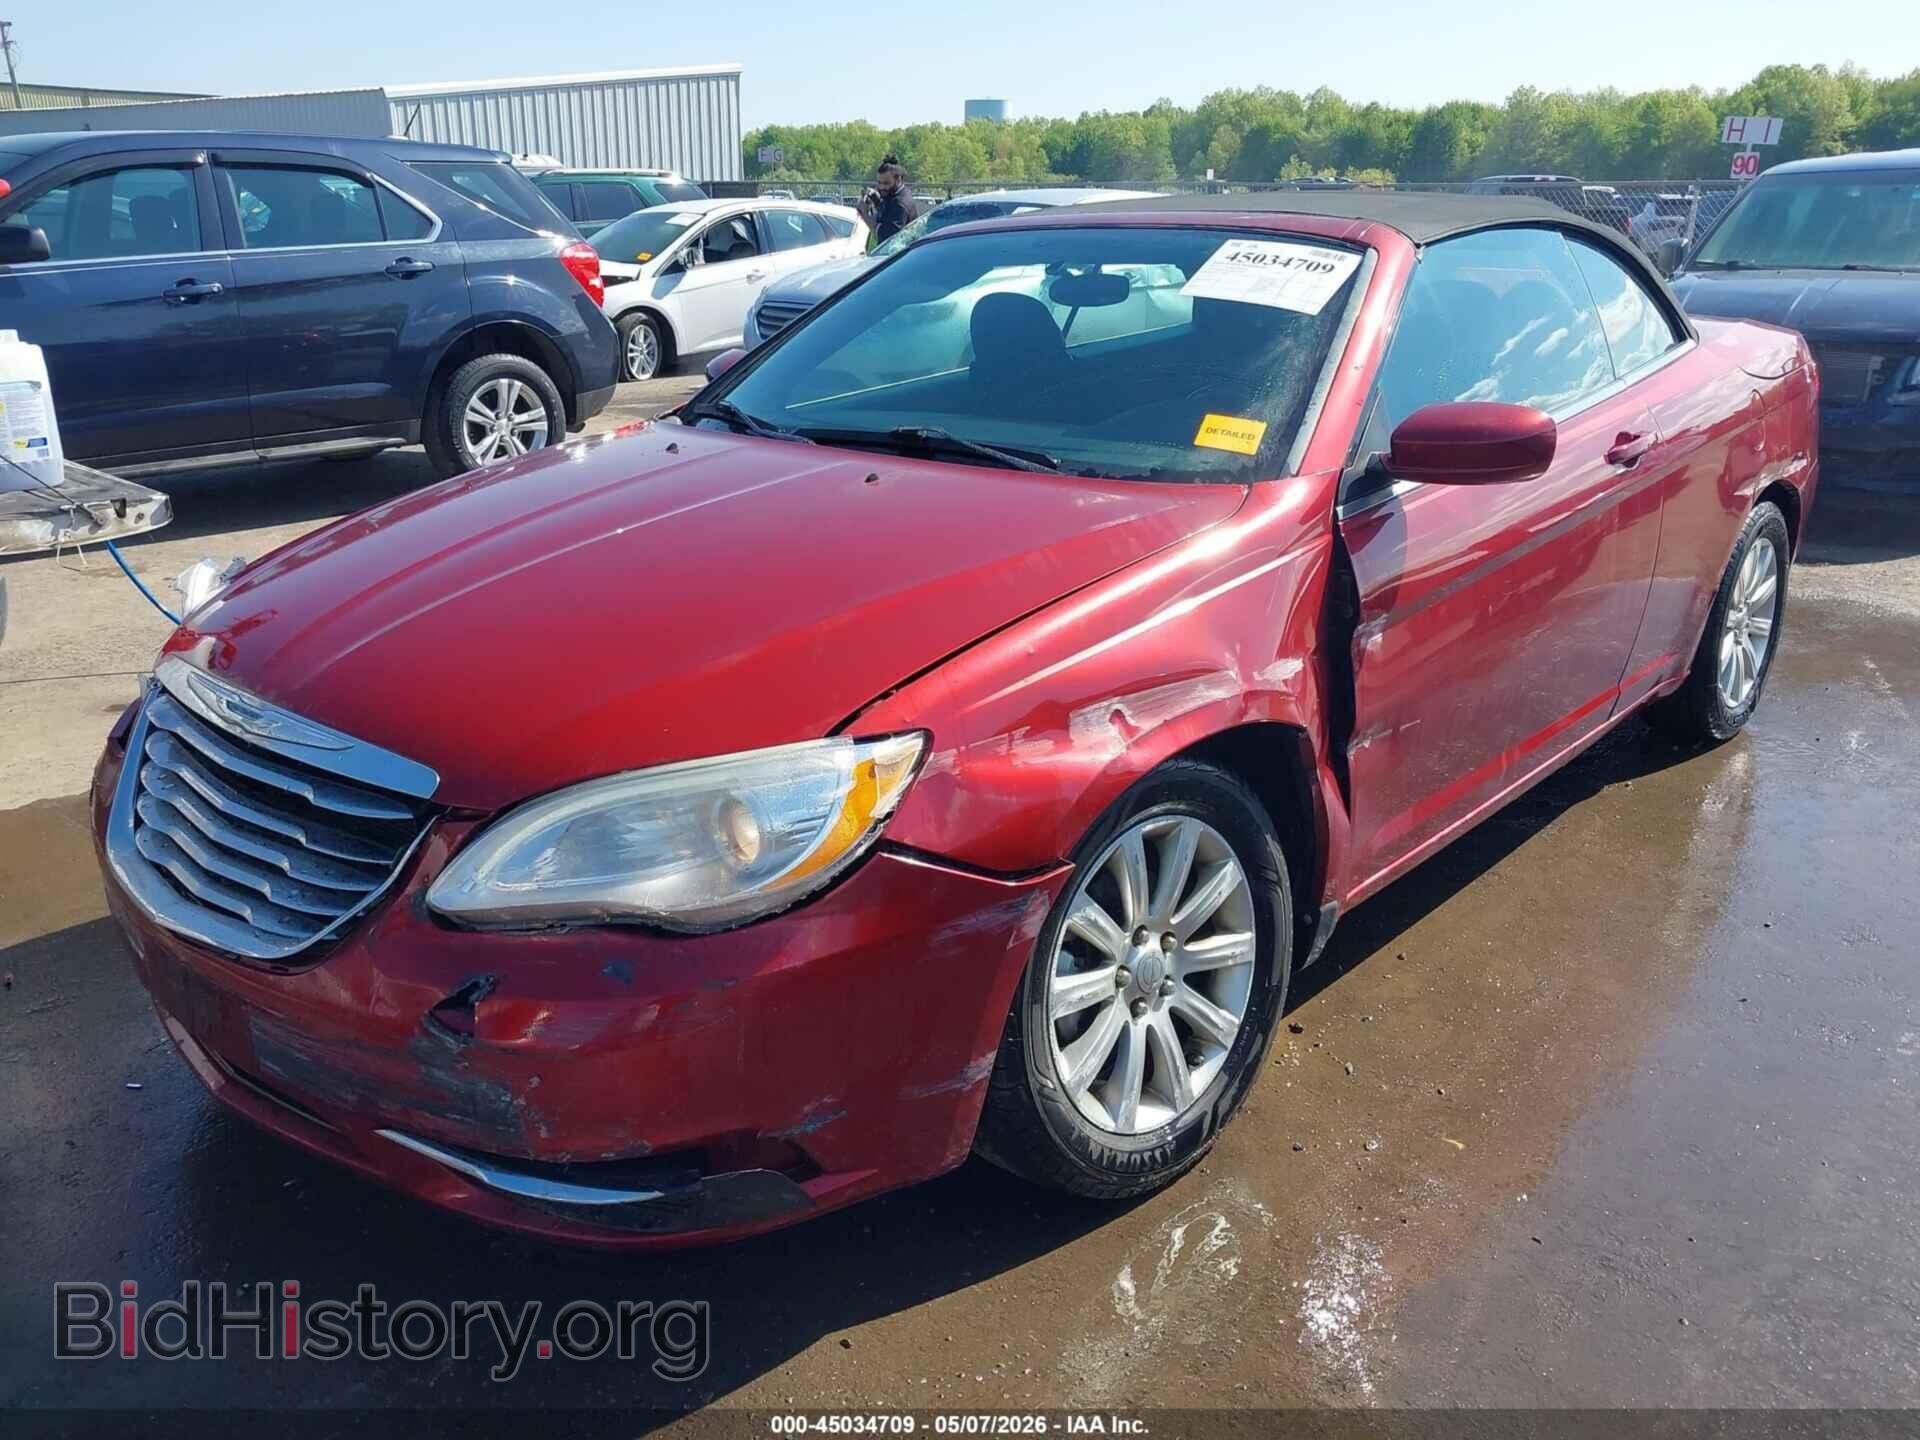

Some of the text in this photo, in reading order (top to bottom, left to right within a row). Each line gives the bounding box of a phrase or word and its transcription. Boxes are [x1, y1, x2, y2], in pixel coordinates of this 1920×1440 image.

[1727, 118, 1747, 142] H
[1733, 155, 1758, 175] 90
[1226, 251, 1335, 274] 45034709
[1206, 427, 1255, 440] DETAILED
